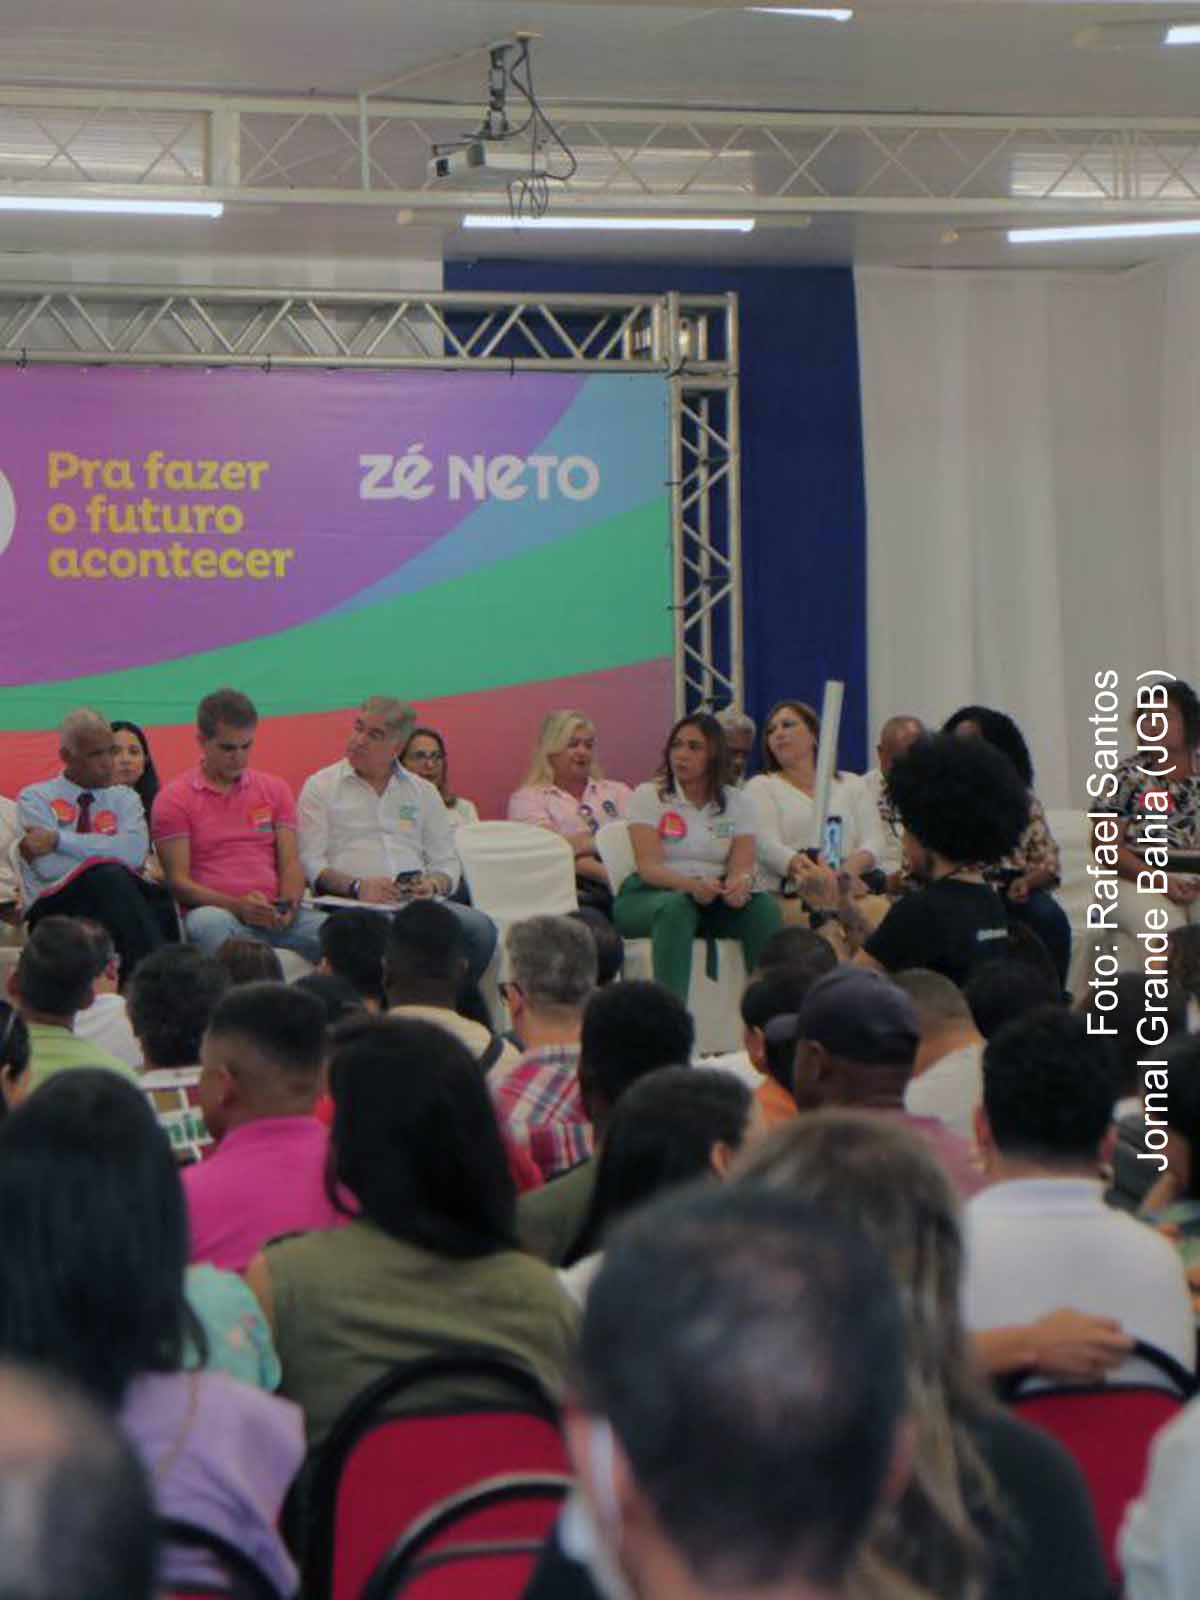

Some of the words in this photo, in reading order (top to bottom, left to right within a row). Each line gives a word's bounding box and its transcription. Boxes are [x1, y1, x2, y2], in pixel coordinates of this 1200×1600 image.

[48, 450, 135, 490] Pra
[143, 450, 269, 490] fazer
[359, 442, 436, 500] Zé
[47, 503, 77, 534] o
[85, 494, 244, 535] futuro
[47, 542, 295, 578] acontecer
